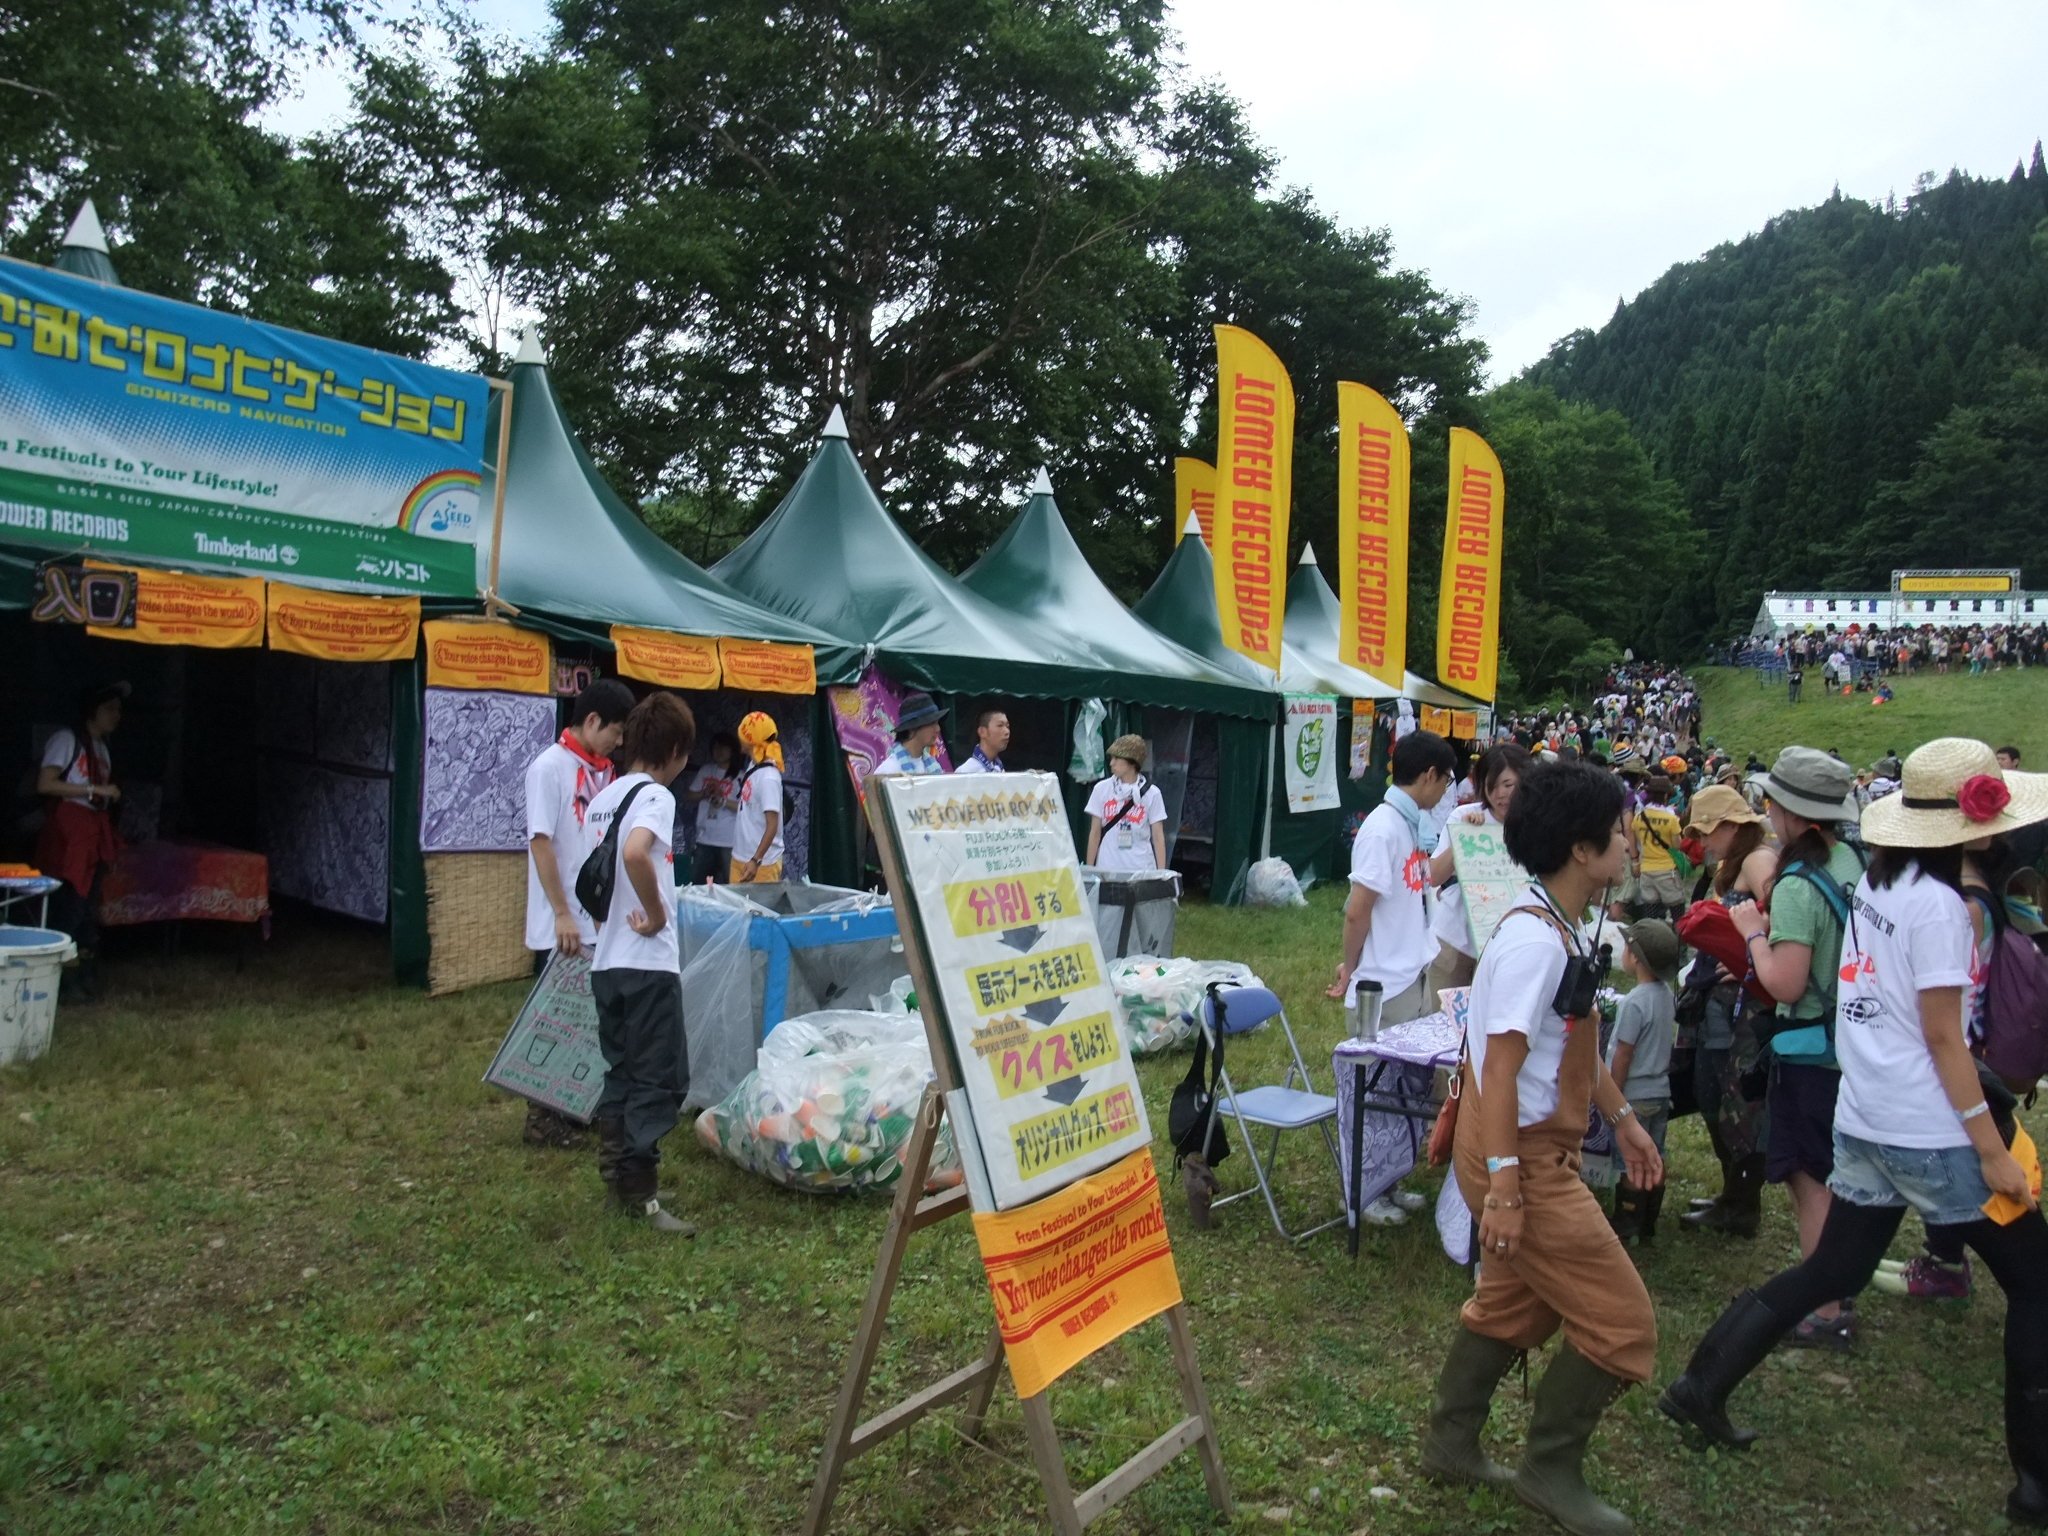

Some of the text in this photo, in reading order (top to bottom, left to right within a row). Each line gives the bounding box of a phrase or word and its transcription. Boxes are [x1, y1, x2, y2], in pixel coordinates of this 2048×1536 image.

[126, 382, 346, 437] GOMIZERO NAVIGATION
[16, 439, 107, 468] Festivals
[115, 458, 134, 473] to
[141, 461, 187, 481] Your
[192, 470, 279, 497] Lifestyle!
[51, 509, 129, 542] RECORDS
[194, 532, 278, 563] Timberland
[380, 559, 431, 583] ソトコト
[32, 567, 128, 626] 入口
[907, 806, 935, 827] WE
[1015, 1227, 1041, 1246] From
[1041, 1212, 1078, 1237] Festival
[1078, 1205, 1088, 1218] to
[1104, 1171, 1139, 1201] Lifestyle!
[1053, 1214, 1116, 1257] A SEED JAPAN
[1028, 1266, 1059, 1303] voice
[1059, 1238, 1108, 1280] changes
[1108, 1223, 1128, 1258] the
